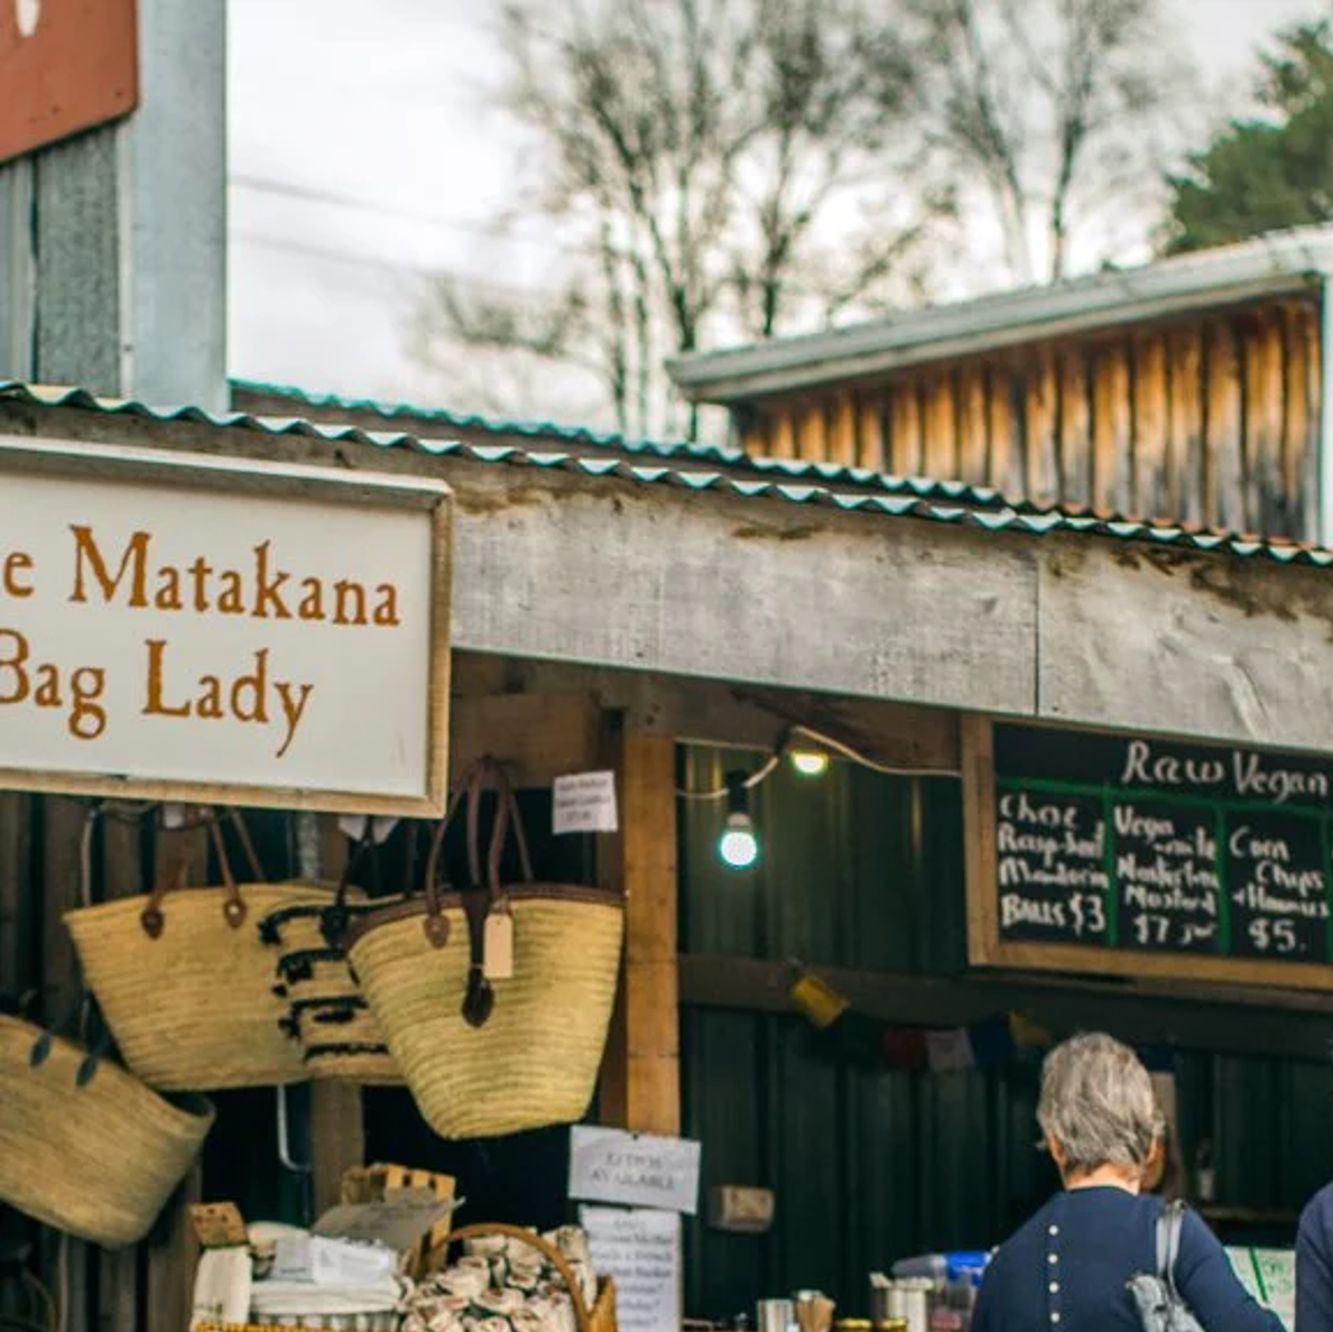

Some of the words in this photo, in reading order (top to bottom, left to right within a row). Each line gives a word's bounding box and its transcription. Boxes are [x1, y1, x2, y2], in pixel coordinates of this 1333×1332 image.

[69, 524, 400, 627] Matakana
[0, 628, 107, 740] Bag
[141, 639, 314, 759] Lady
[1121, 740, 1225, 784] Raw
[1232, 751, 1328, 804] Vegan
[1068, 891, 1106, 937] $3
